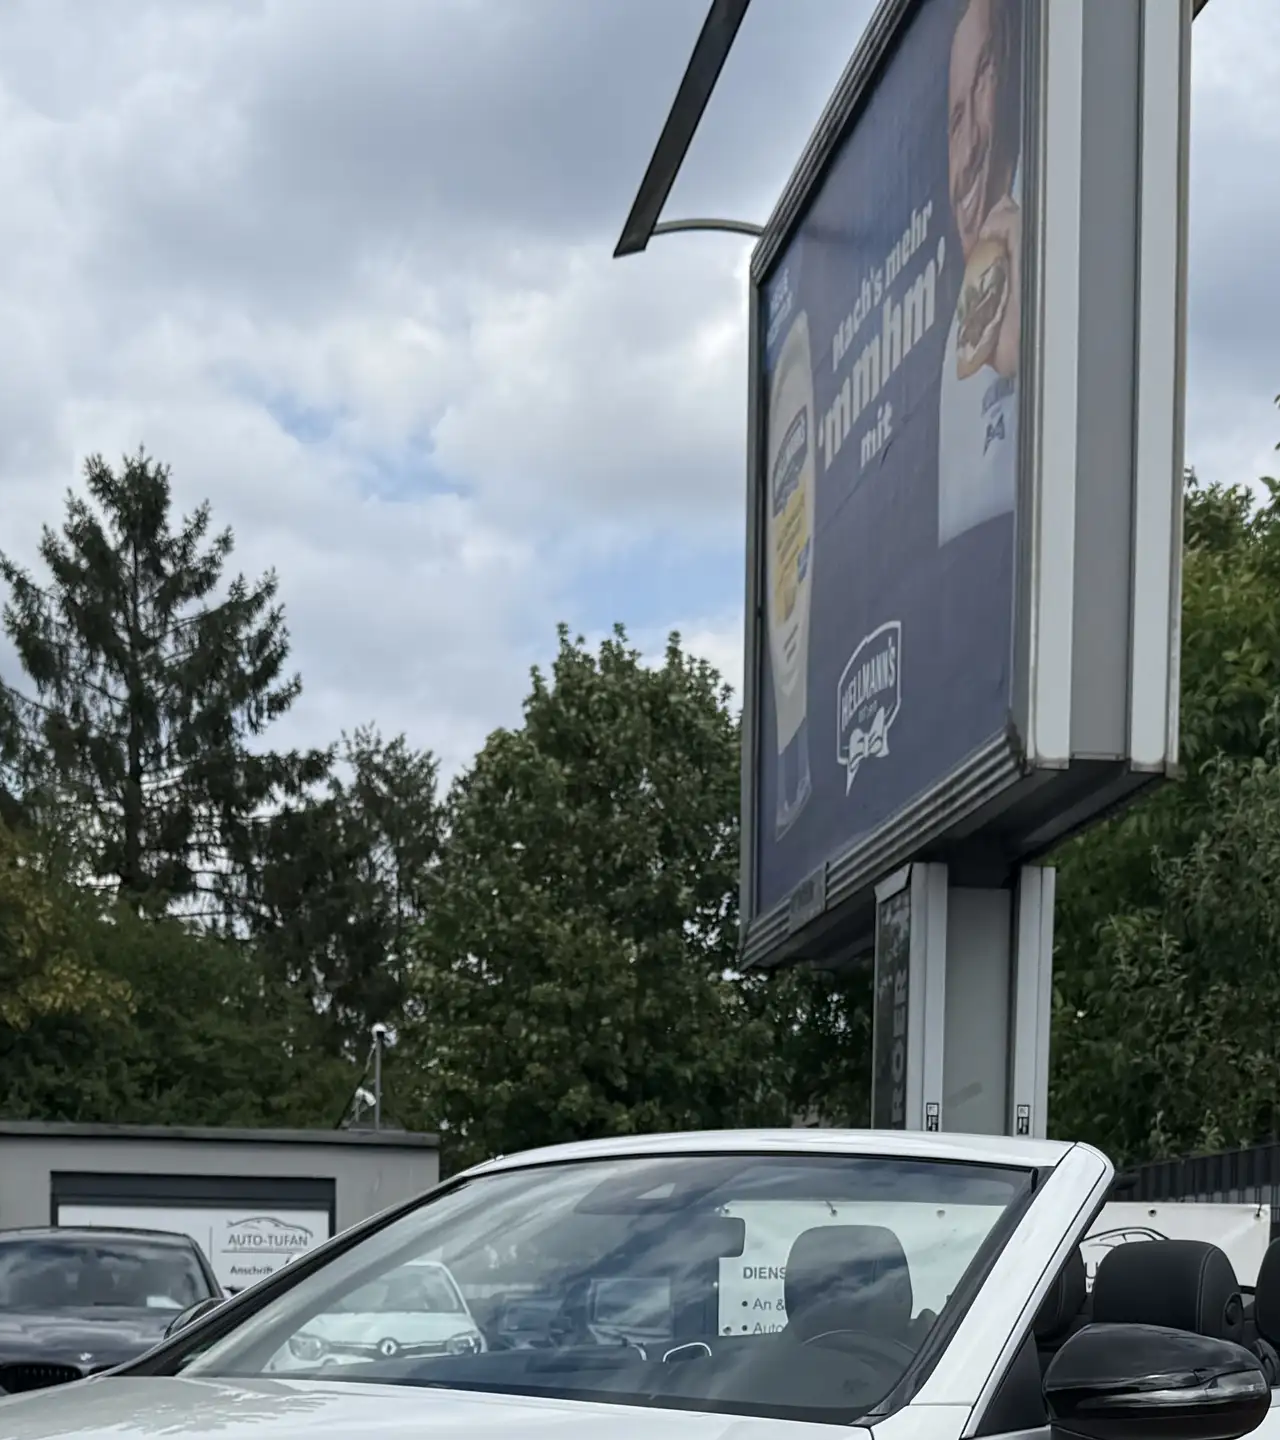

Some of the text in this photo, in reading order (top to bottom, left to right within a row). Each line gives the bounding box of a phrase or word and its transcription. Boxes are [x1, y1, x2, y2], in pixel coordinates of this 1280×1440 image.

[885, 199, 933, 290] mehr
[860, 401, 893, 470] mit
[227, 1233, 308, 1247] AUTO-TUFAN
[742, 1266, 786, 1280] DIENS
[752, 1298, 772, 1311] An
[753, 1322, 784, 1335] Auto
